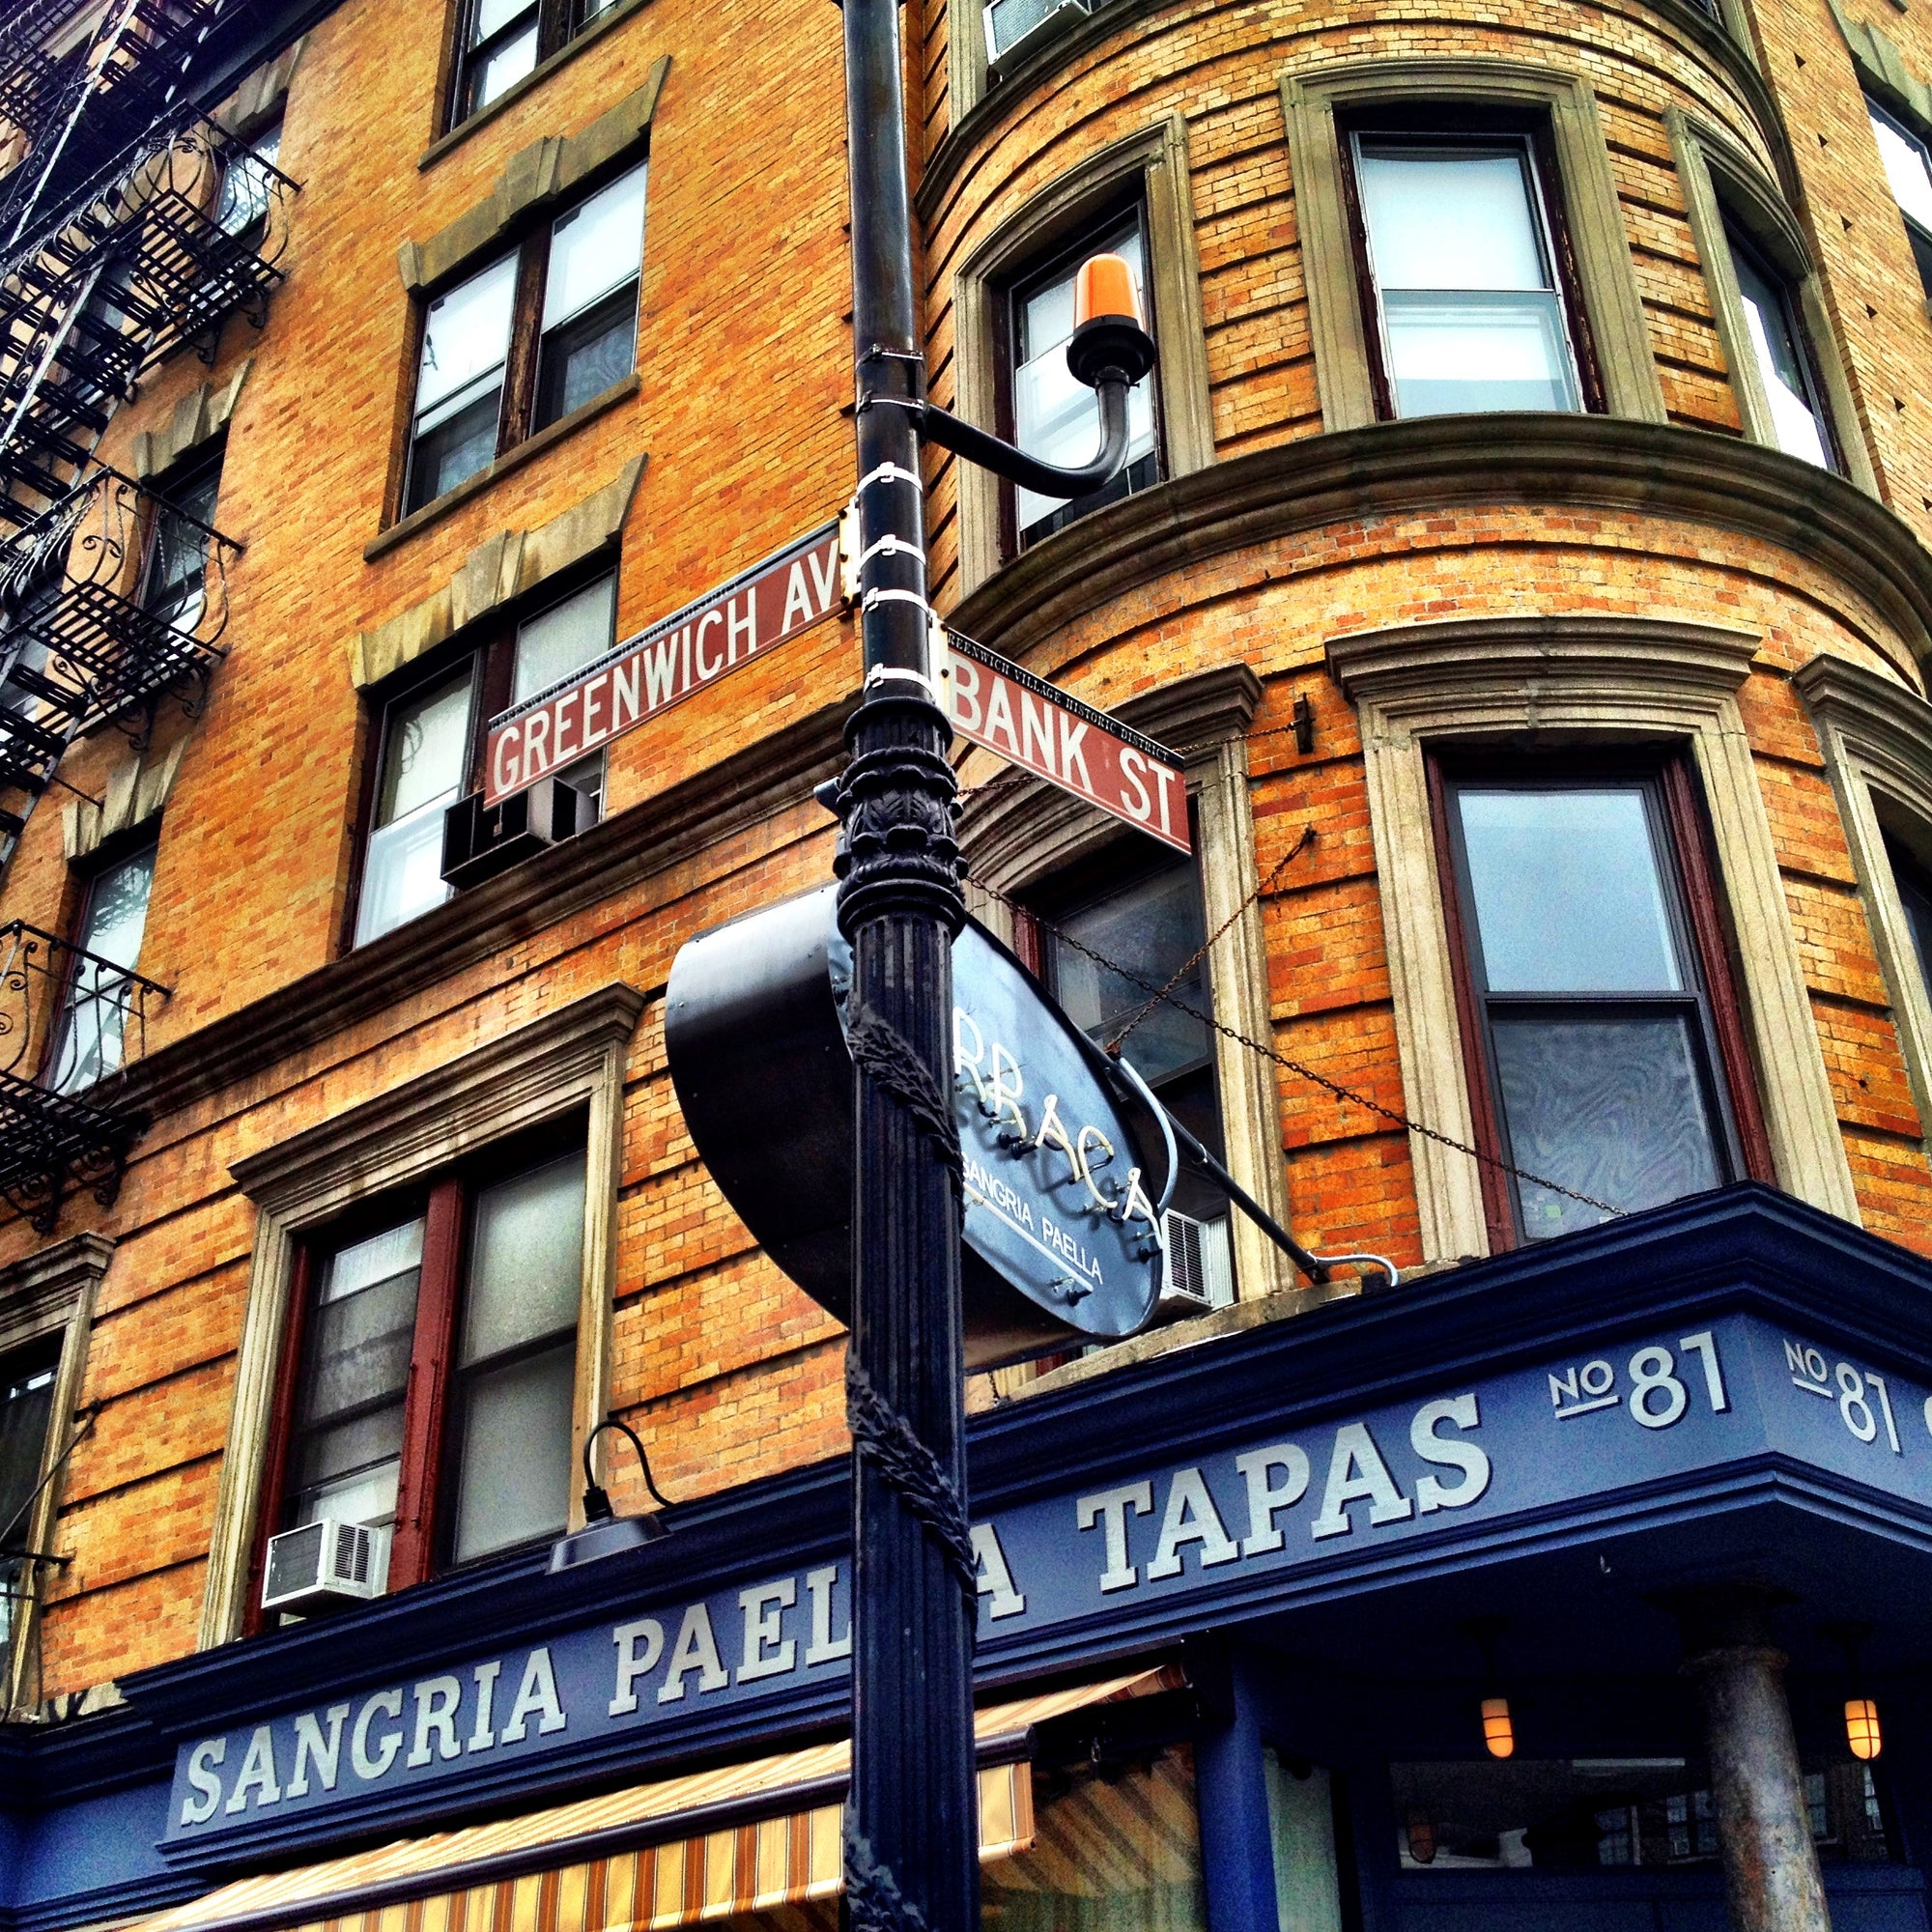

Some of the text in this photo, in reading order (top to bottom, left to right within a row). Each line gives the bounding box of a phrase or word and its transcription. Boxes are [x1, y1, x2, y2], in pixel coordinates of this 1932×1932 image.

[493, 586, 757, 798] GREENWICH
[781, 538, 839, 637] AV
[947, 632, 1169, 763] REENWICH VILLAGE HISTORIC DISTRICT
[949, 653, 1177, 837] BANK ST
[952, 1006, 1162, 1251] RRACA
[1041, 1216, 1103, 1286] PAELLA
[1628, 1330, 1726, 1429] 81
[1835, 1361, 1901, 1453] 81
[180, 1393, 1490, 1826] SANGRIA PAELA TAPAS
